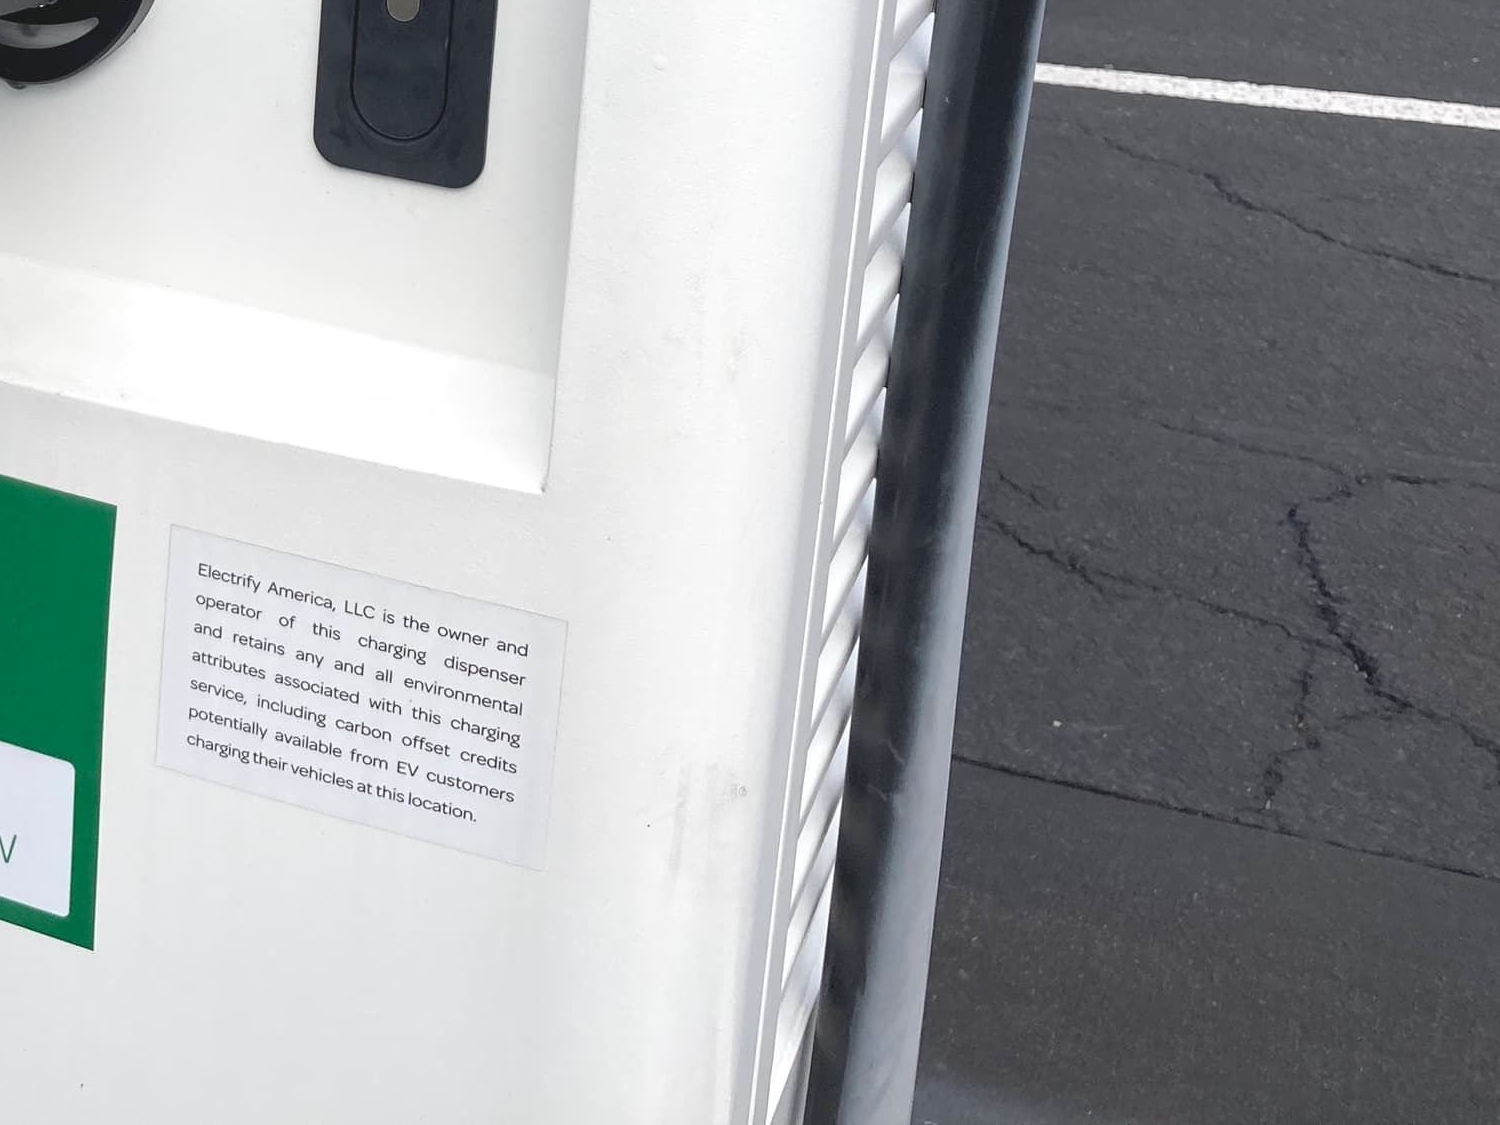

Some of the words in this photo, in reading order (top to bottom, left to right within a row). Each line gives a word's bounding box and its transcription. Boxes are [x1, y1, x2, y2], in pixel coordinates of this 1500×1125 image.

[196, 595, 263, 620] operator
[278, 615, 296, 629] of
[313, 622, 341, 641] this
[358, 635, 427, 665] charging
[444, 655, 526, 686] dispenser
[198, 563, 261, 594] Electrify
[267, 582, 336, 612] America,
[344, 600, 376, 619] LLC
[383, 609, 395, 624] is
[403, 615, 430, 633] the
[437, 626, 490, 647] owner
[496, 640, 529, 657] and
[192, 651, 266, 680] attributes
[274, 673, 360, 705] associated
[369, 697, 402, 715] with
[412, 707, 441, 725] this
[450, 717, 521, 749] charging
[194, 623, 222, 639] and
[233, 633, 285, 656] retains
[295, 650, 324, 668] any
[334, 660, 364, 676] and
[375, 669, 393, 683] all
[404, 678, 523, 716] environmental
[188, 707, 268, 740] potentially
[275, 731, 342, 758] available
[350, 748, 388, 770] from
[397, 760, 419, 777] EV
[426, 771, 515, 803] customers
[190, 679, 247, 705] service,
[257, 694, 326, 728] including
[335, 719, 392, 742] carbon
[401, 735, 450, 757] offset
[460, 751, 517, 774] credits
[186, 734, 250, 764] charging
[253, 752, 288, 771] their
[290, 764, 354, 790] vehicles
[357, 782, 373, 795] at
[376, 785, 405, 803] this
[408, 792, 476, 822] location.
